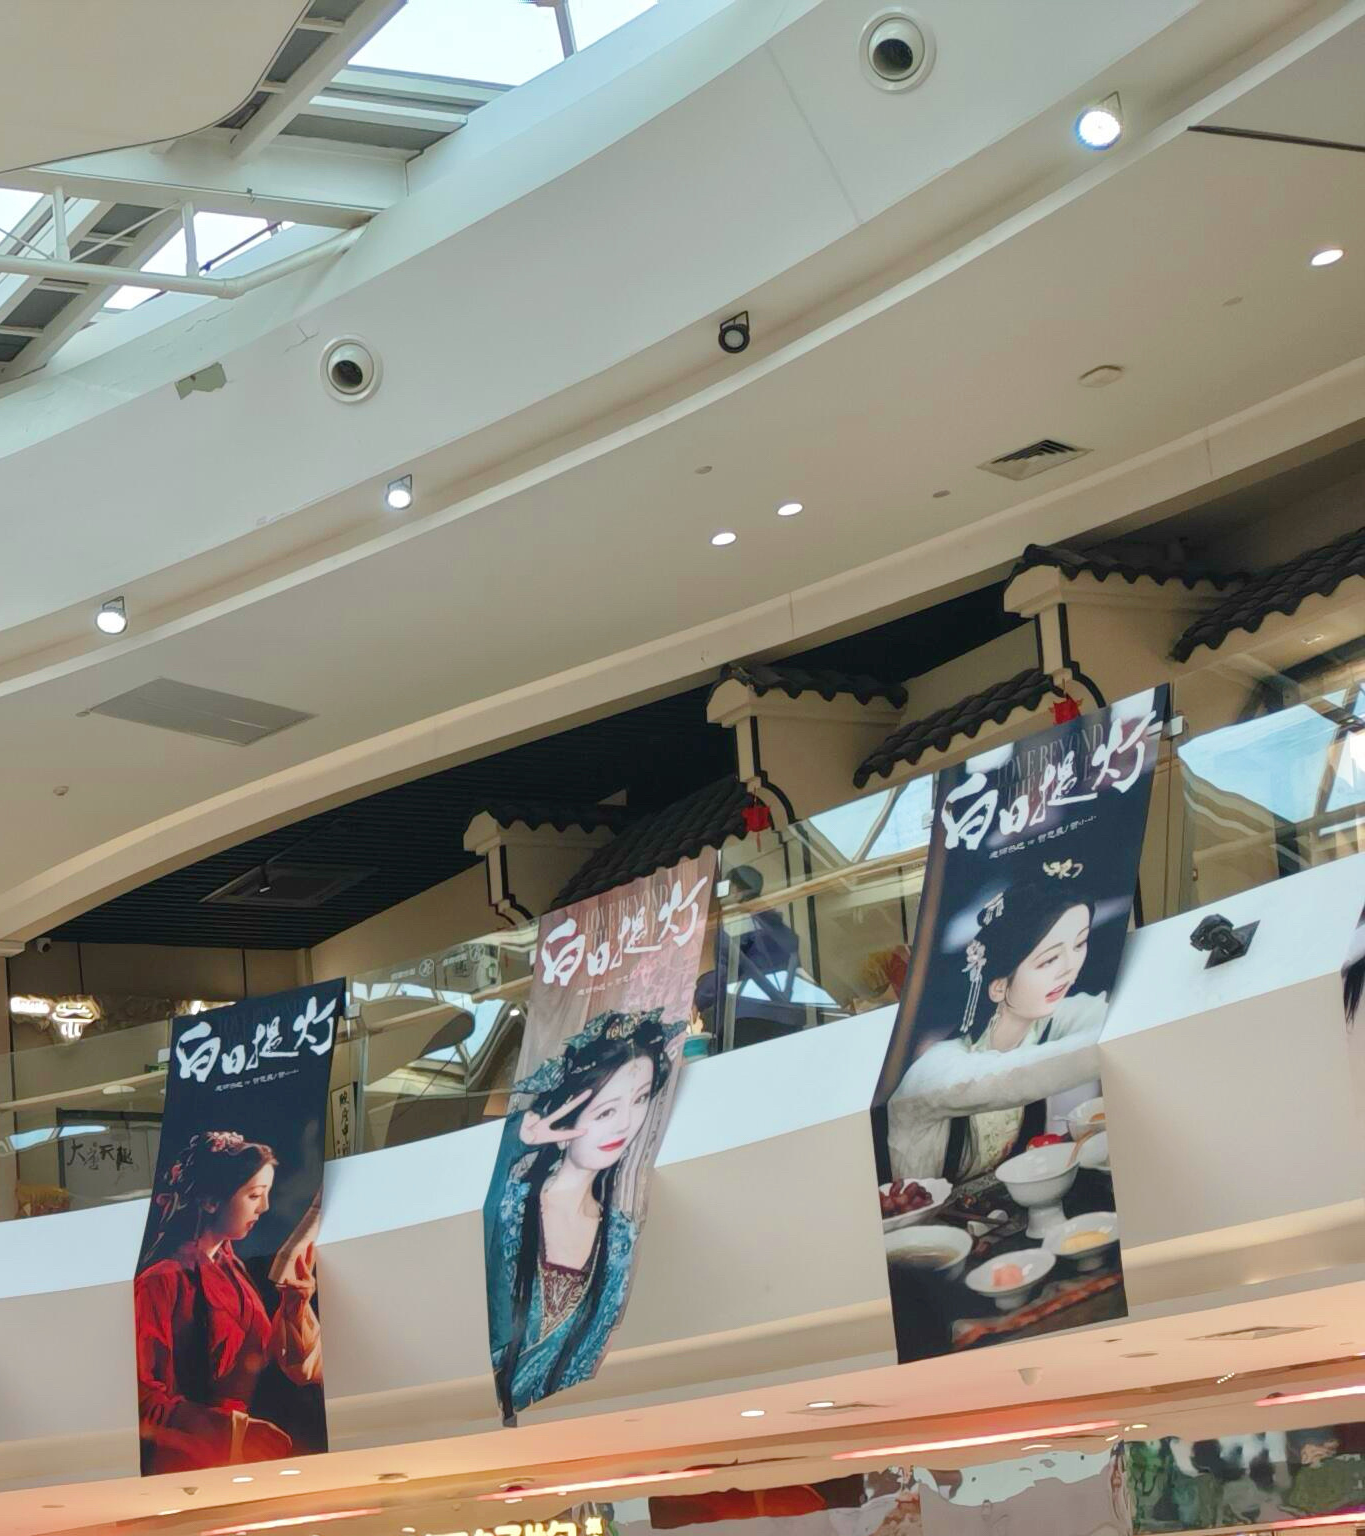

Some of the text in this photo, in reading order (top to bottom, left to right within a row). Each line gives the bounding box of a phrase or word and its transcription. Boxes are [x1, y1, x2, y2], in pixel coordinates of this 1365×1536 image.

[941, 710, 1157, 851] 白日提灯
[541, 876, 708, 986] 白日提灯
[176, 996, 337, 1083] 白日提灯
